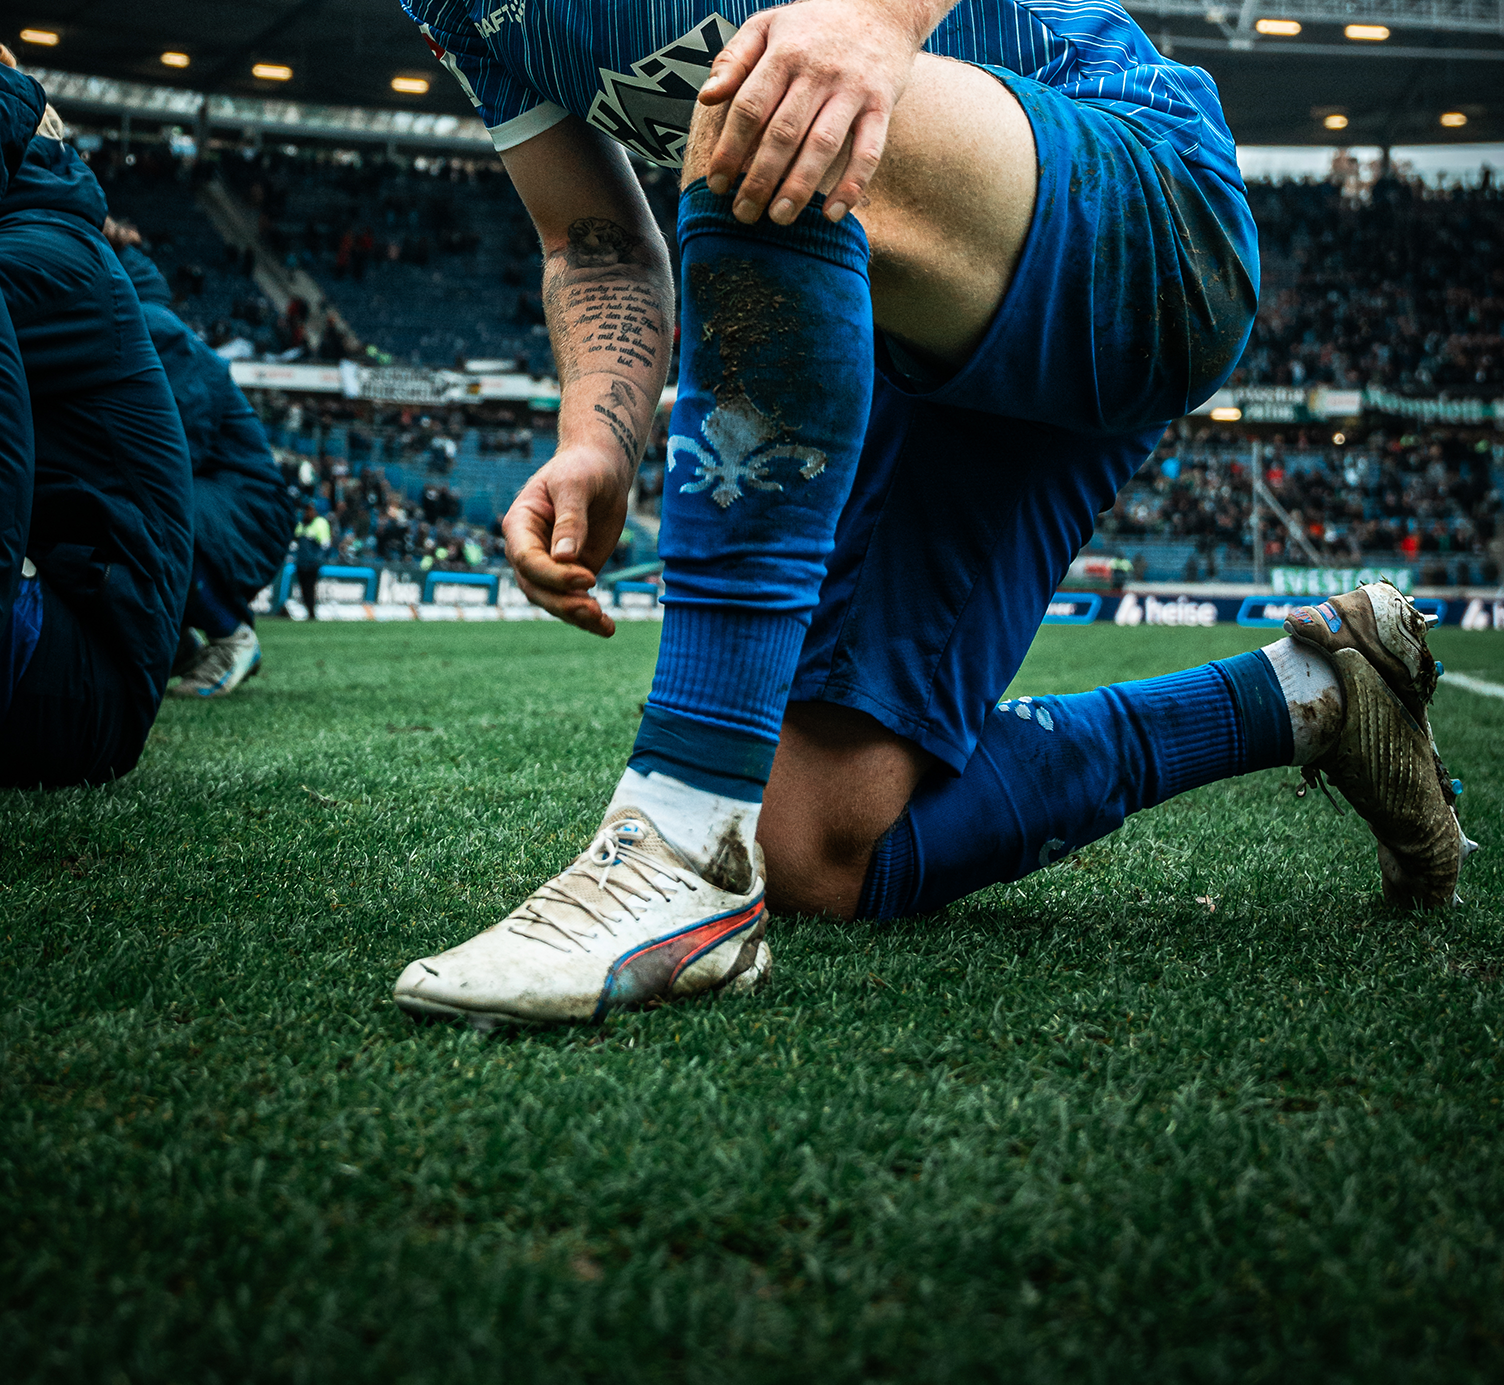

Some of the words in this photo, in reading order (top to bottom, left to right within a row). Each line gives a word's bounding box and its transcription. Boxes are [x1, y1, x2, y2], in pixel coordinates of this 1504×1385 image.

[597, 332, 614, 340] mit
[605, 343, 618, 352] du
[1145, 595, 1218, 627] heise
